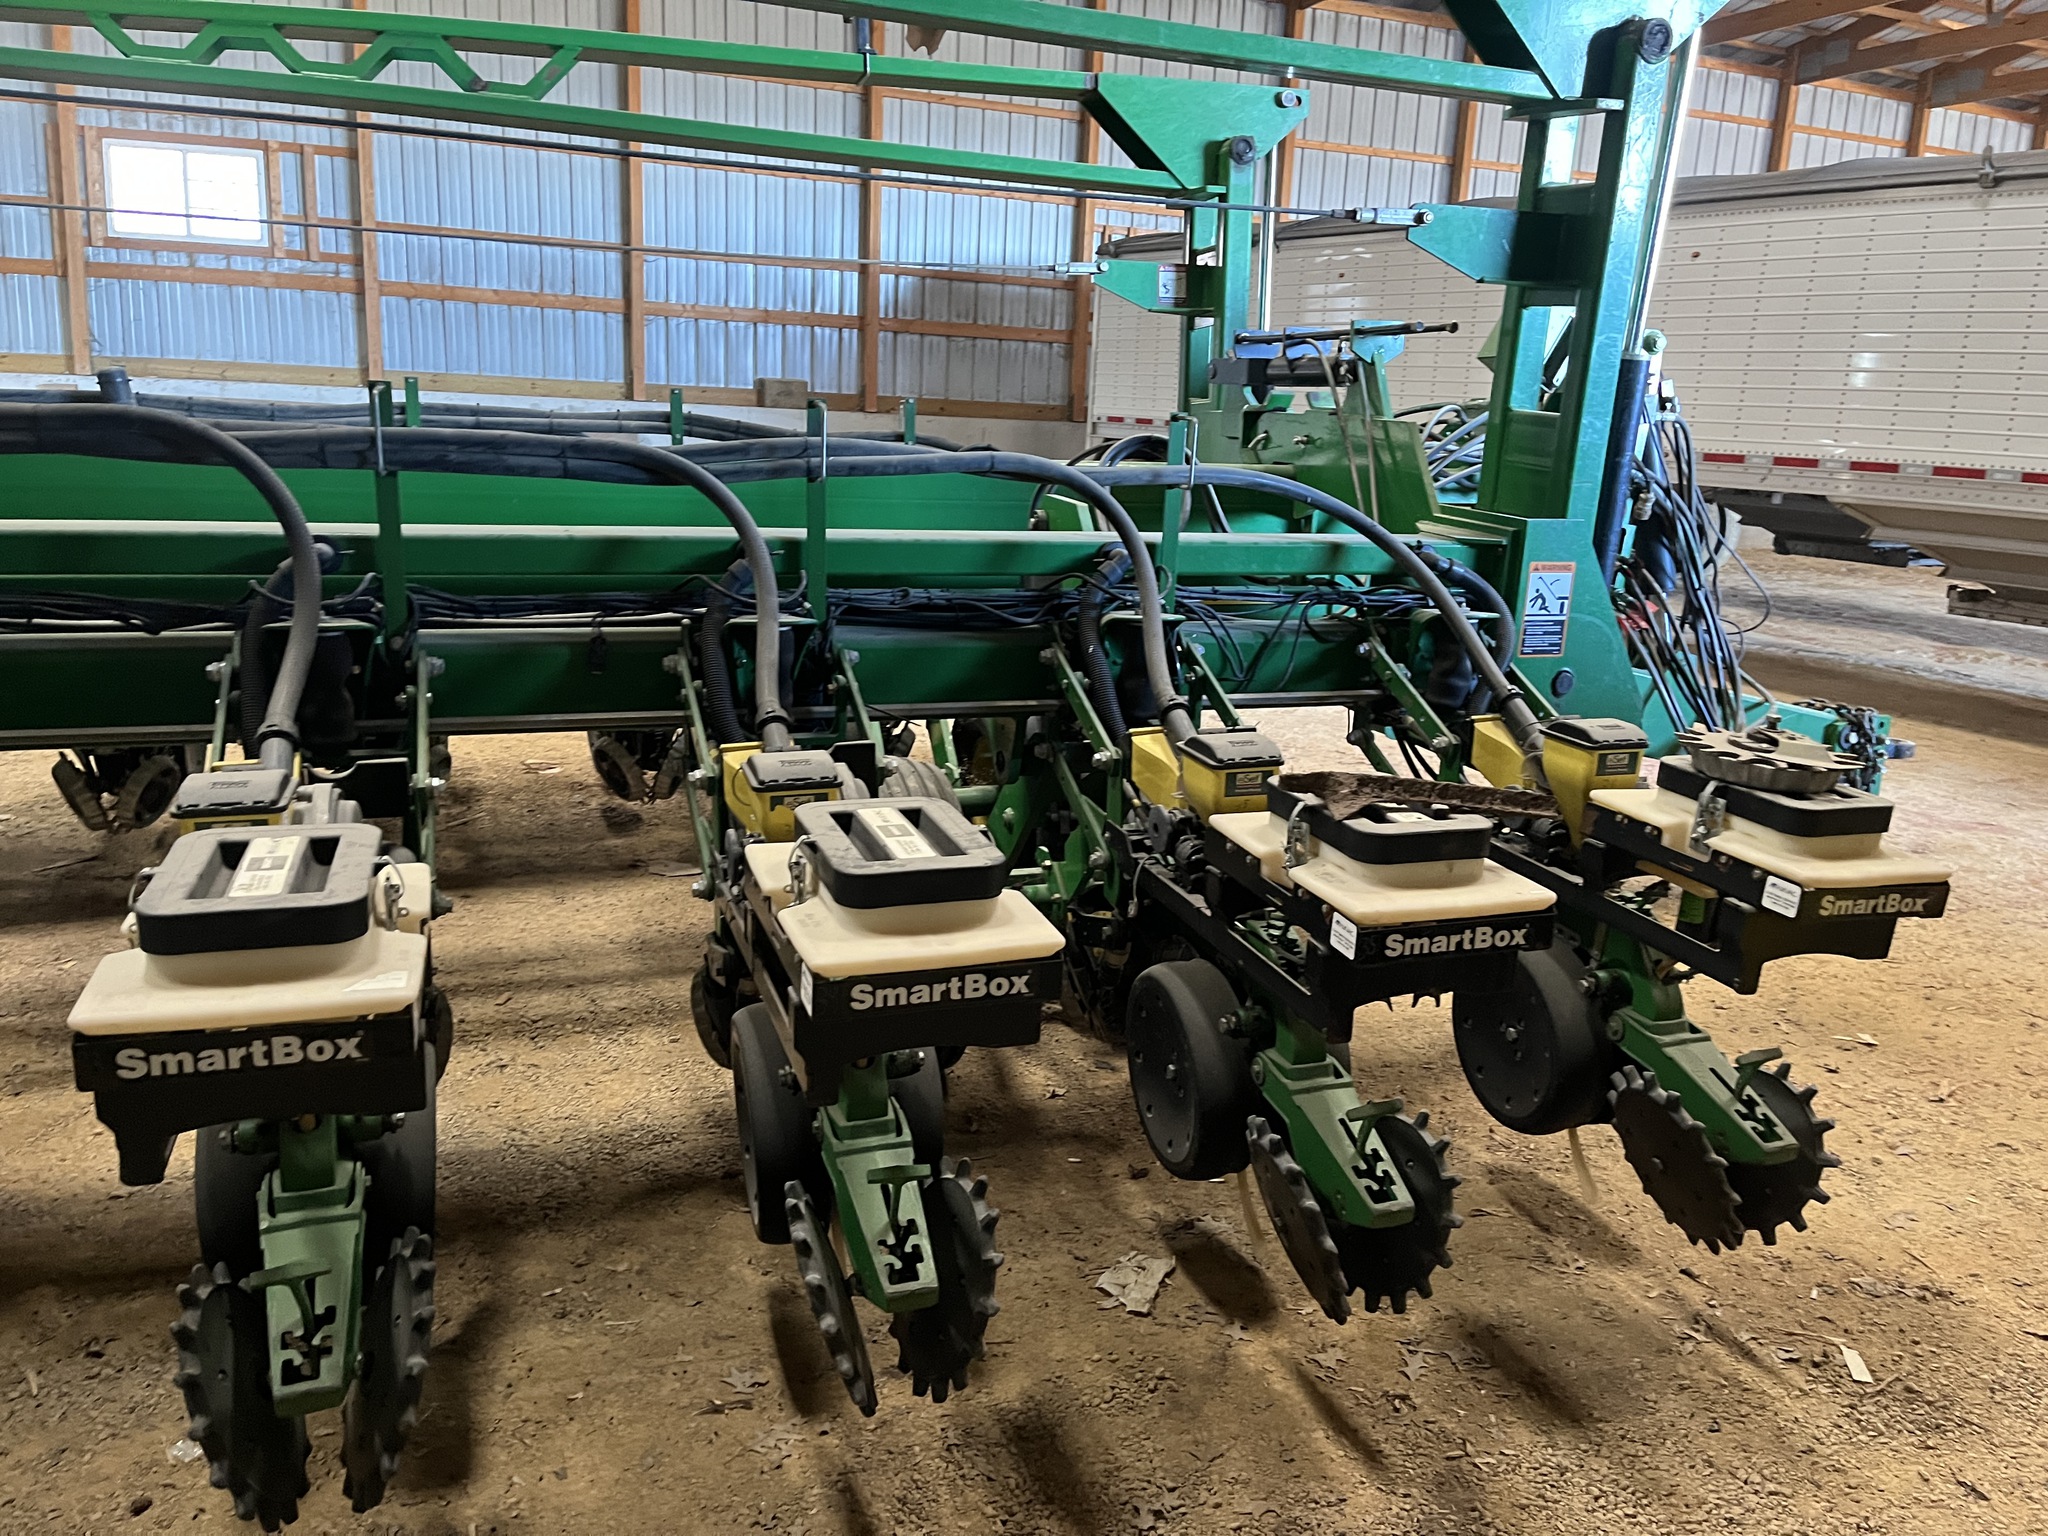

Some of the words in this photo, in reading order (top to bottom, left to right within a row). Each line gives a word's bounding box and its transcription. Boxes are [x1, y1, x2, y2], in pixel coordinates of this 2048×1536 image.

[1818, 893, 1929, 917] SmartBox
[1384, 926, 1528, 958] SmartBox
[850, 973, 1031, 1011] SmartBox
[115, 1034, 363, 1080] SmartBox
